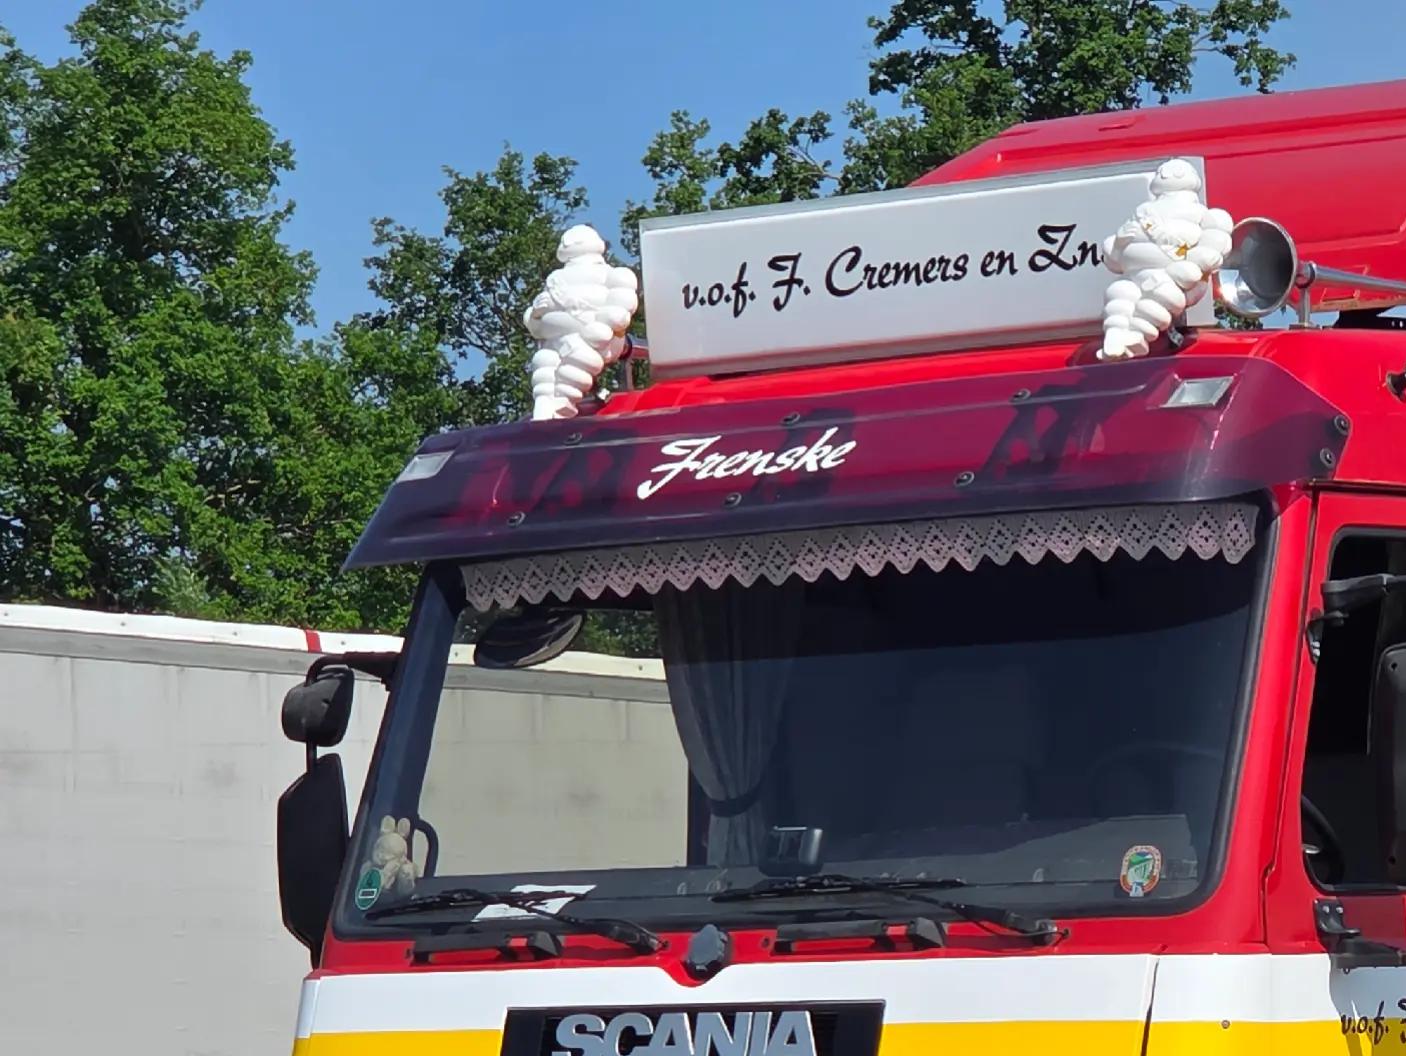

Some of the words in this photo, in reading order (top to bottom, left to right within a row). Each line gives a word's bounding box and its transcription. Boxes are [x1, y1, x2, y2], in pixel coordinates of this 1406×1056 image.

[682, 261, 756, 318] v.o.f.
[825, 246, 969, 297] Cremers
[980, 249, 1018, 277] en
[636, 427, 857, 500] Frenske
[1341, 1000, 1389, 1045] v.o.f.
